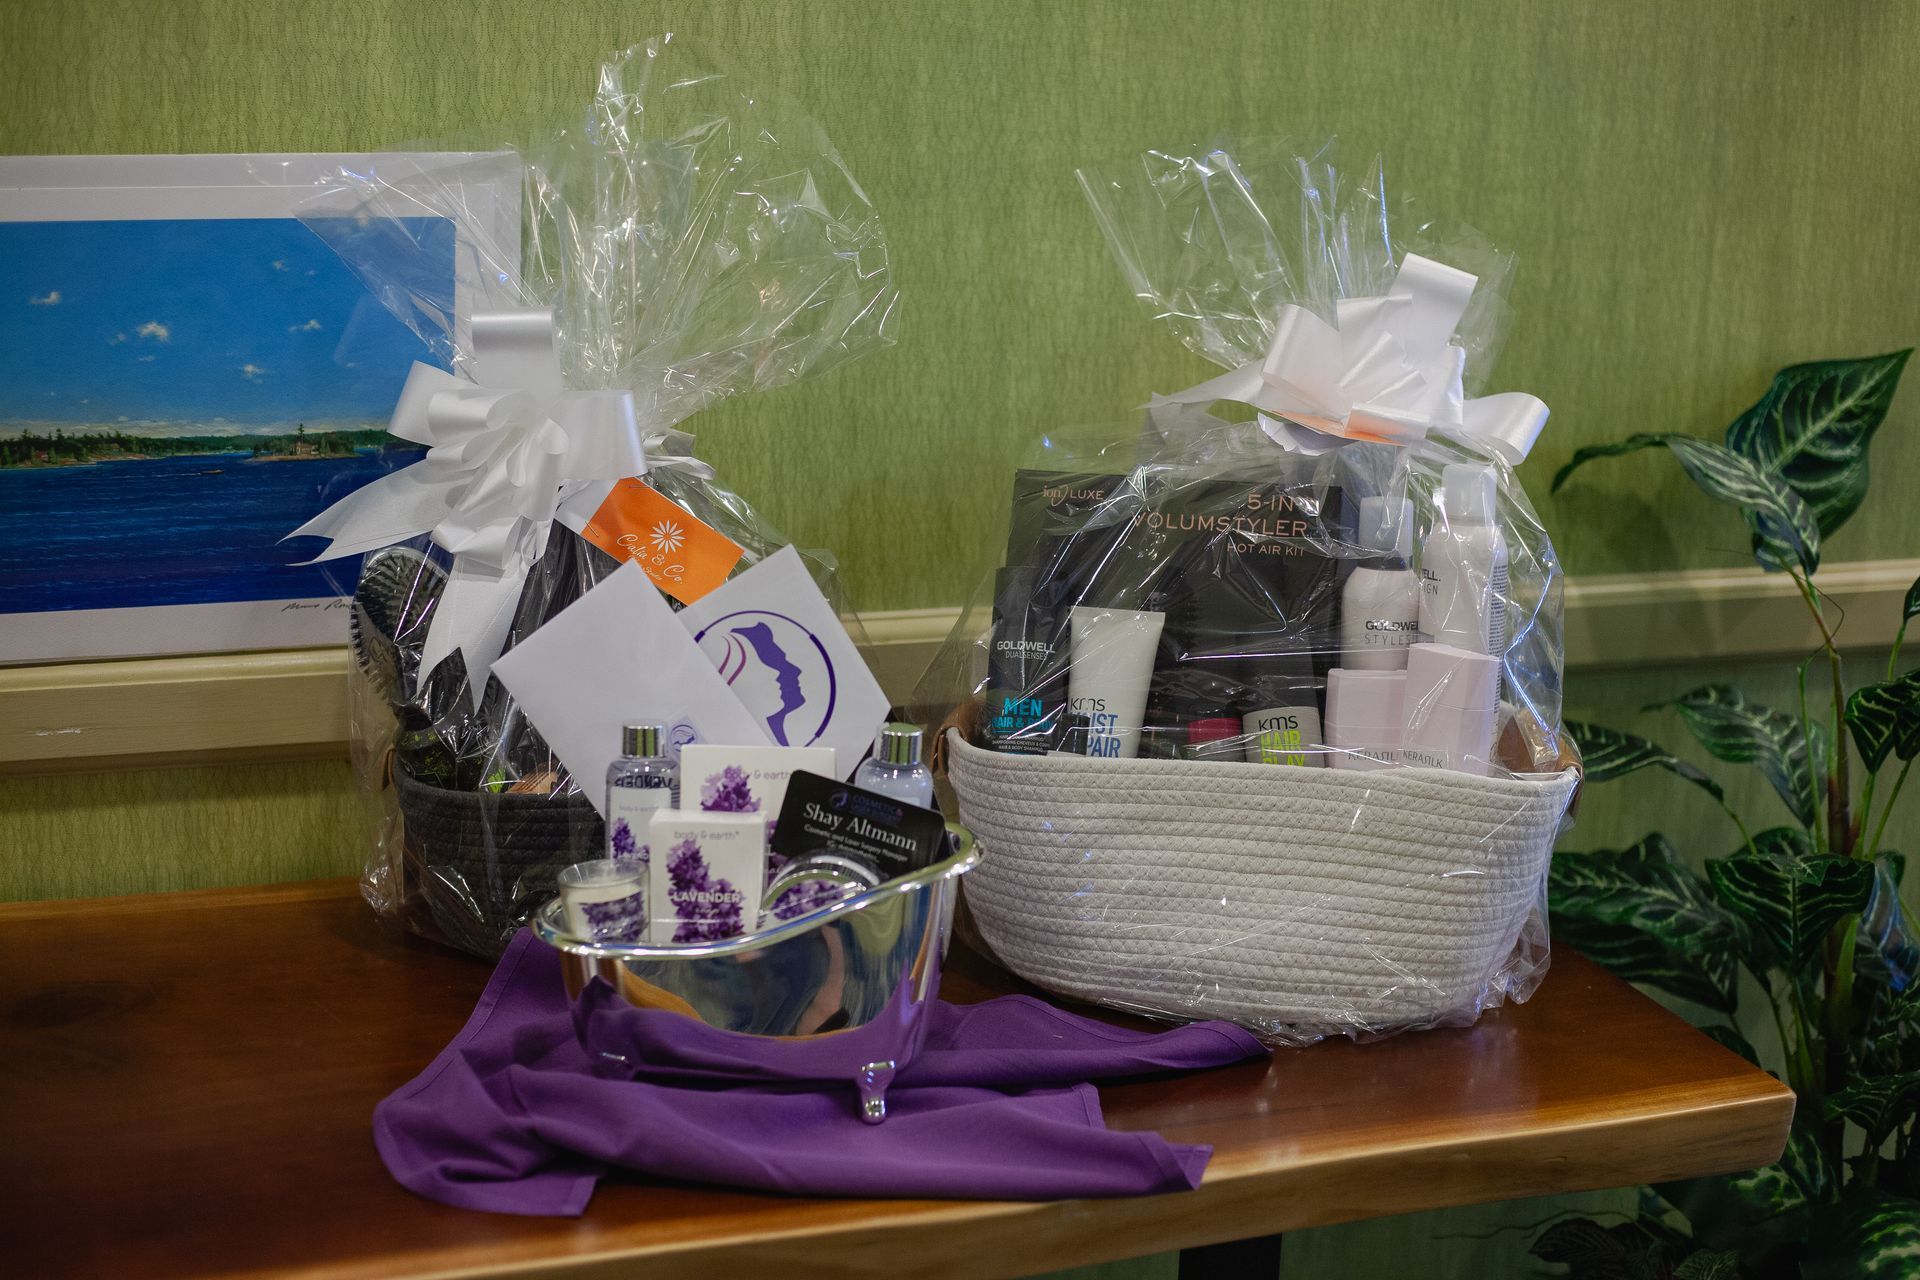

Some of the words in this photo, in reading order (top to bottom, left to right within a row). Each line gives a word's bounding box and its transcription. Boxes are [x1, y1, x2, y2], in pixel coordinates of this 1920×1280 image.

[1070, 490, 1105, 500] LUXE
[1131, 510, 1308, 537] VOLUMSTYLER
[1227, 543, 1256, 553] HOT
[1258, 545, 1281, 555] AIR
[1285, 546, 1305, 556] KIT
[1365, 620, 1419, 632] GOLDWE
[997, 640, 1056, 653] GOLDWELL
[1364, 634, 1414, 646] STYLES
[1005, 650, 1047, 660] DUALSENSES
[1003, 697, 1043, 716] MEN
[991, 716, 1014, 728] HAIR
[1015, 717, 1025, 728] &
[1081, 712, 1119, 734] IST
[1258, 715, 1299, 731] kms
[1087, 735, 1121, 758] PAIR
[1261, 730, 1301, 757] HAIR
[803, 802, 843, 831] Shay
[846, 817, 918, 852] Altmann
[673, 891, 741, 904] LAVENDER
